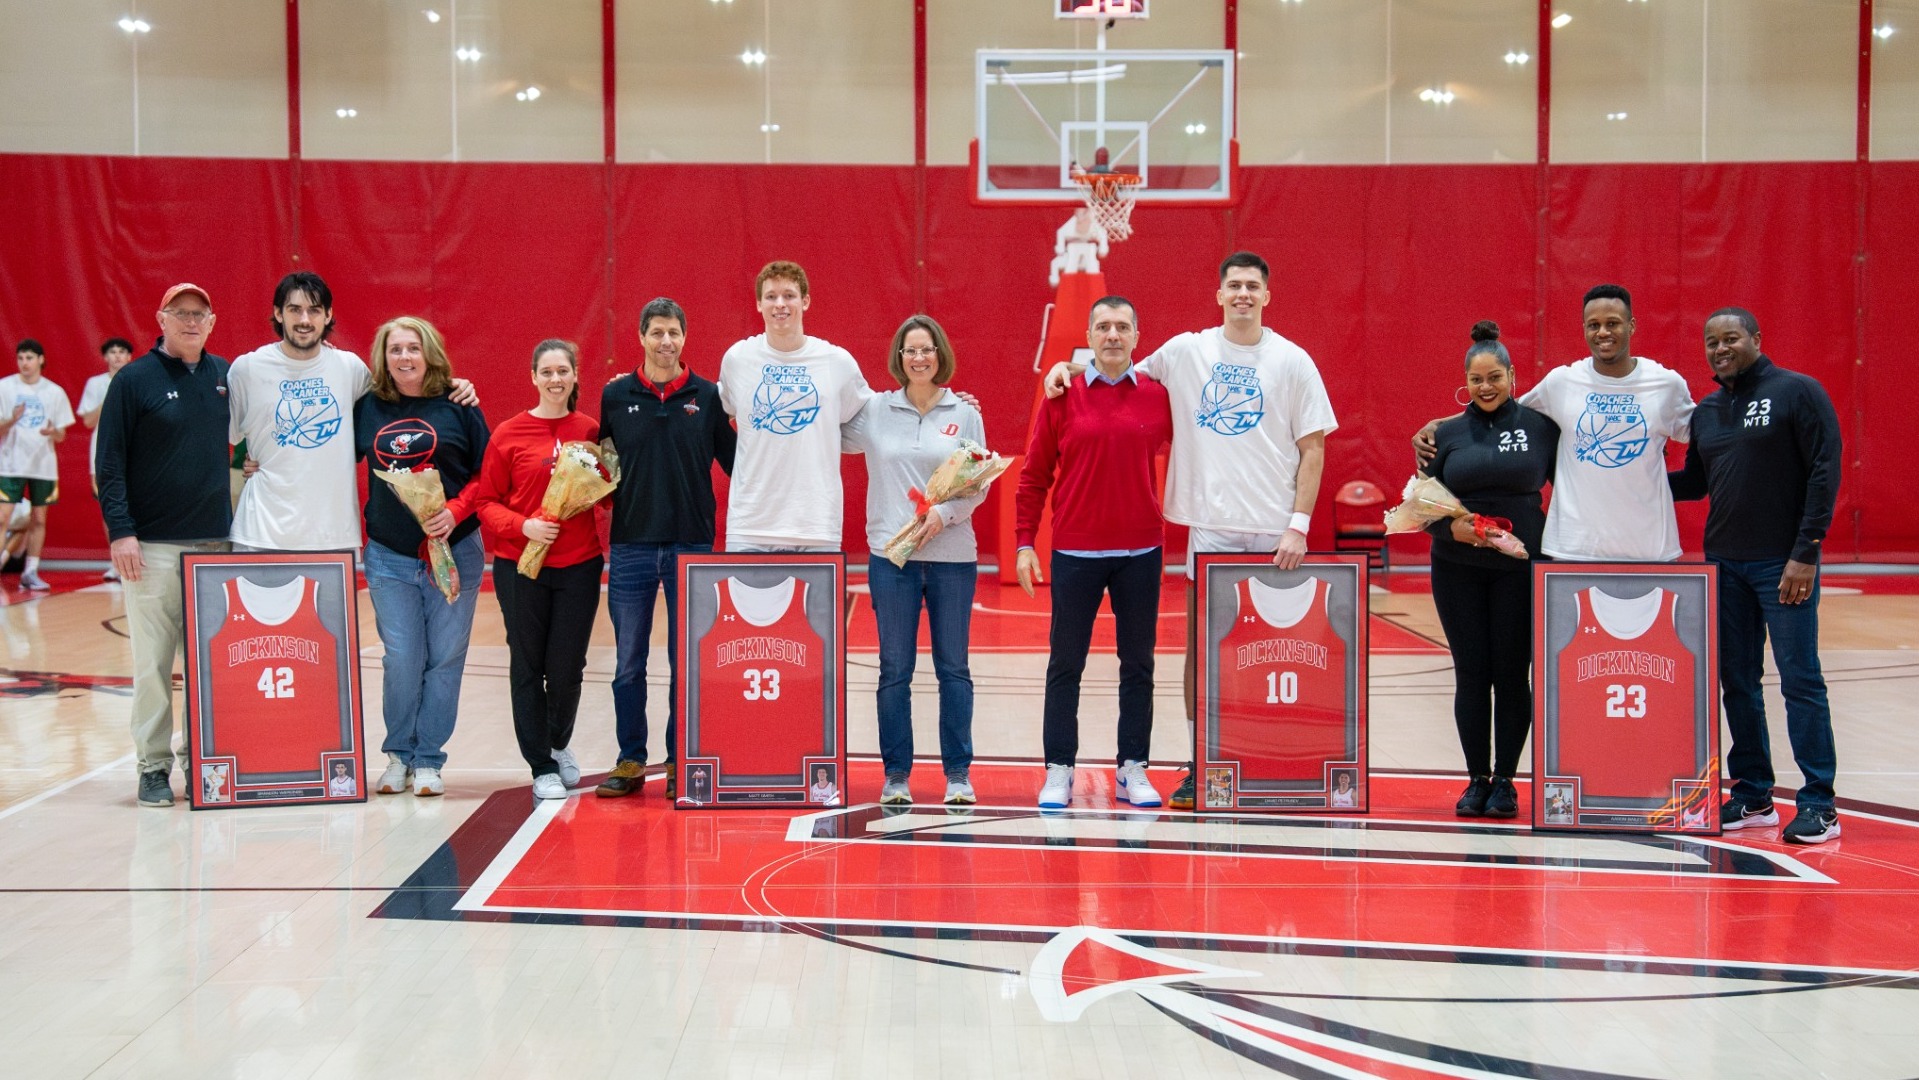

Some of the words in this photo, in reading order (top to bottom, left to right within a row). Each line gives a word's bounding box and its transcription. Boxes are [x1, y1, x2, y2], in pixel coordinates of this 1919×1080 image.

[762, 364, 807, 376] COACHES
[1212, 362, 1256, 377] COACHES
[280, 378, 323, 391] COACHES
[773, 375, 811, 385] CANCER
[1222, 373, 1259, 388] CANCER
[293, 387, 329, 399] CANCER
[1586, 392, 1634, 404] COACHES
[1598, 404, 1640, 414] CANCER
[1746, 398, 1771, 416] 23
[794, 408, 817, 425] M
[1239, 413, 1261, 427] M
[1743, 415, 1770, 428] WTB
[319, 420, 341, 438] M
[944, 422, 960, 437] D
[1500, 429, 1527, 444] 23
[1498, 443, 1528, 452] WTB
[1620, 440, 1646, 458] M
[228, 635, 320, 667] DICKINSON
[717, 636, 806, 668] DICKINSON
[1237, 638, 1328, 671] DICKINSON
[1577, 650, 1675, 684] DICKINSON
[257, 667, 295, 698] 42
[743, 668, 780, 701] 33
[1266, 671, 1298, 704] 10
[1606, 684, 1647, 718] 23
